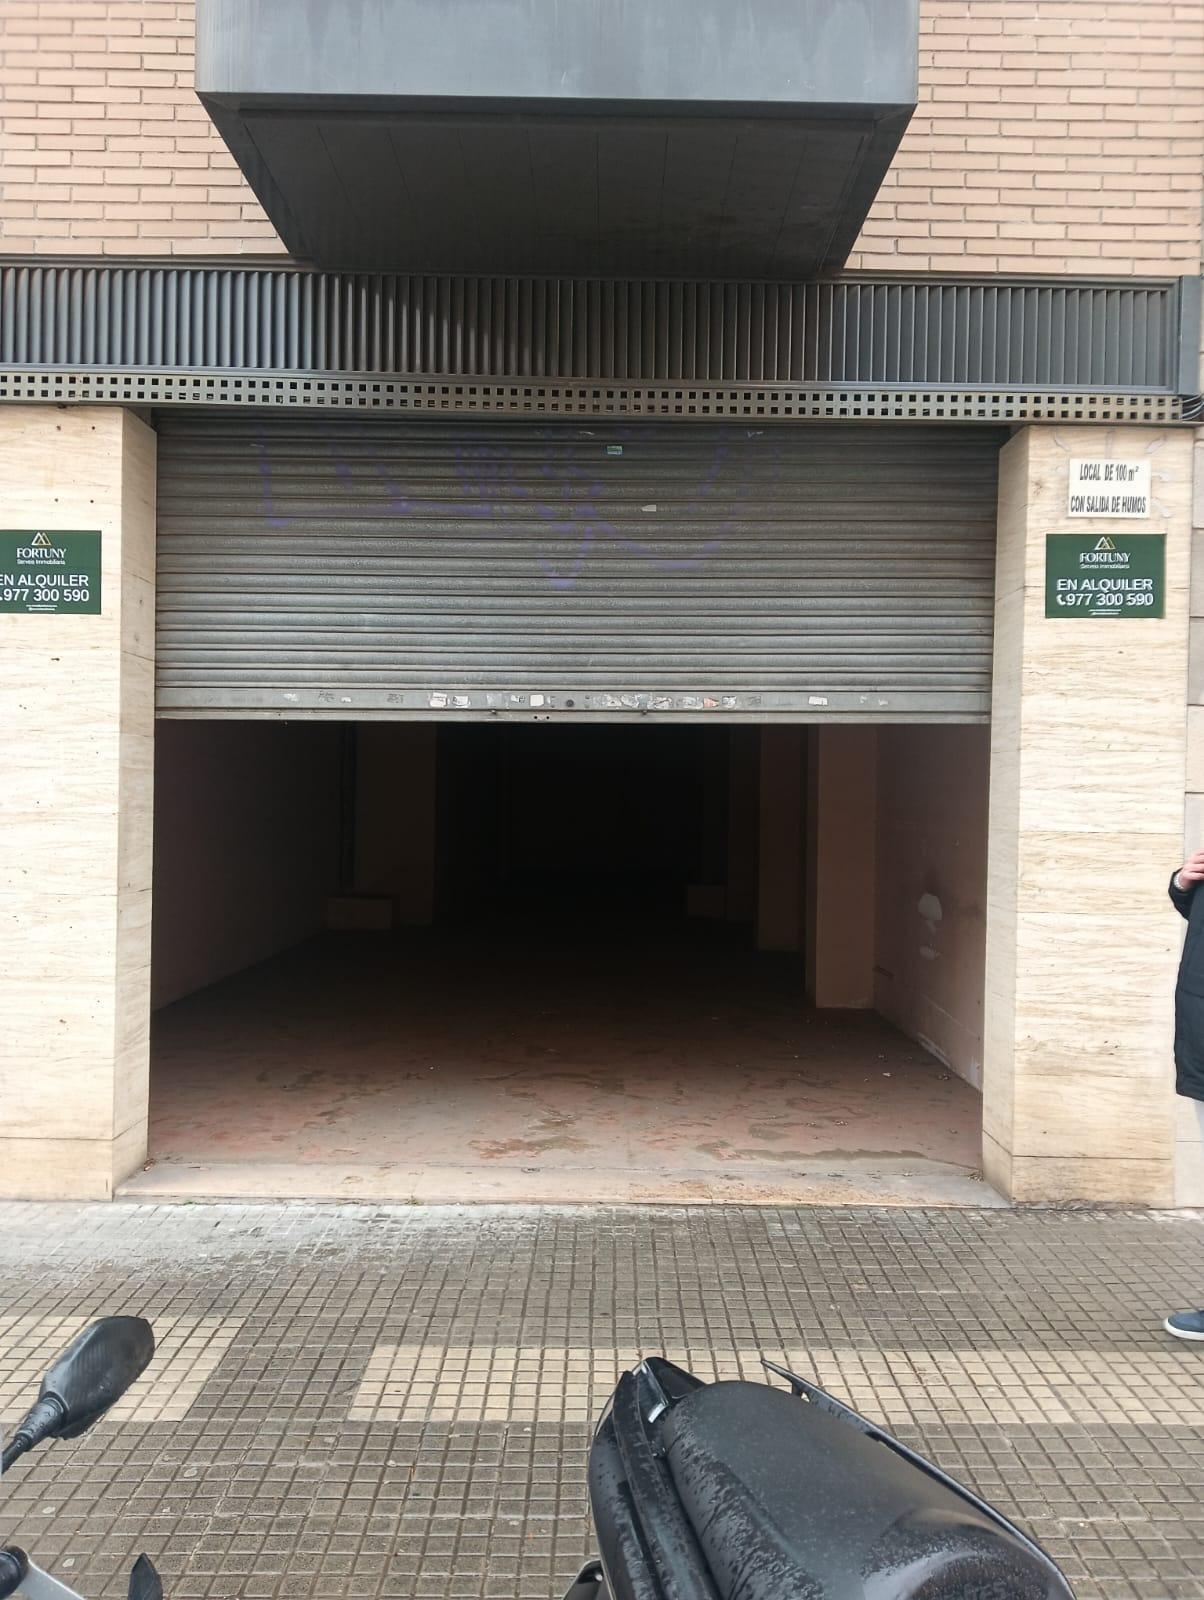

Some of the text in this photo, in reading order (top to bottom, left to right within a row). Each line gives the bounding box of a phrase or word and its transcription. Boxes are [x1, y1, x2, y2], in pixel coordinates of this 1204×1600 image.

[1079, 463, 1101, 481] LOCAL
[1104, 463, 1114, 481] DE
[1115, 464, 1127, 481] 100
[1070, 495, 1147, 513] CON SALIDA DE HUMOS
[16, 547, 67, 558] FORTUNY
[1079, 552, 1131, 562] FORTUNY
[17, 574, 89, 588] ALQUILER
[1056, 578, 1153, 593] EN ALQUILER
[3, 588, 90, 602] 977 300 590
[1065, 593, 1154, 606] 977 300 590
